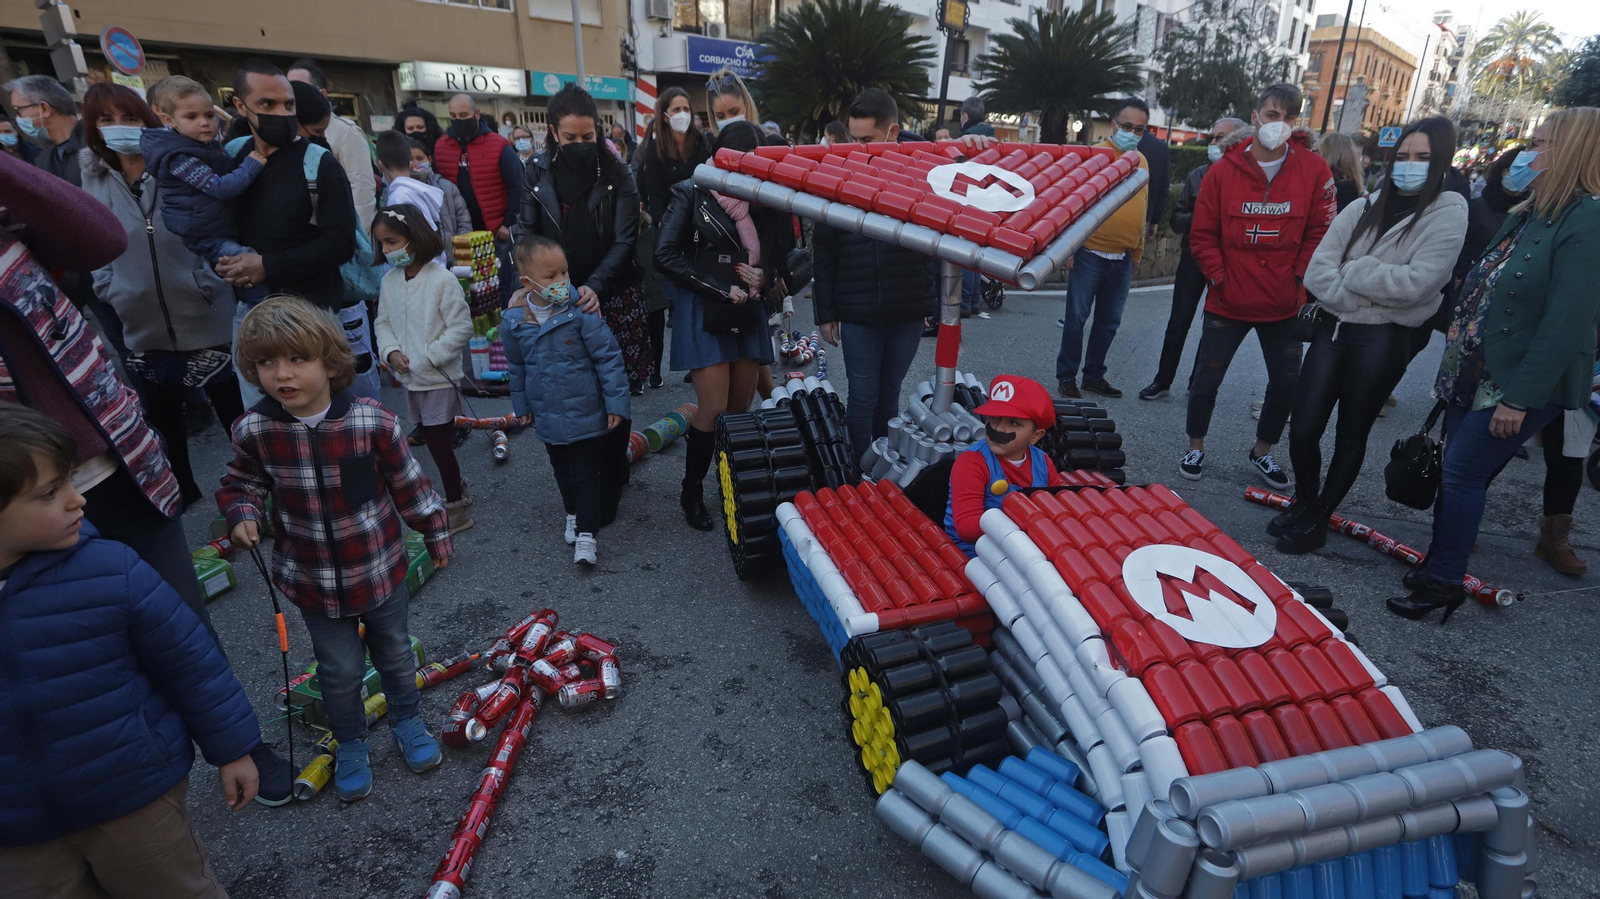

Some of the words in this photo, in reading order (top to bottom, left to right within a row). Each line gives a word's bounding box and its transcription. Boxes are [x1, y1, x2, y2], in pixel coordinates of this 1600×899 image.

[698, 54, 741, 67] CORBACHO
[949, 171, 1025, 198] M
[1243, 202, 1288, 215] NORWAY
[993, 384, 1010, 399] M
[1155, 564, 1258, 622] M
